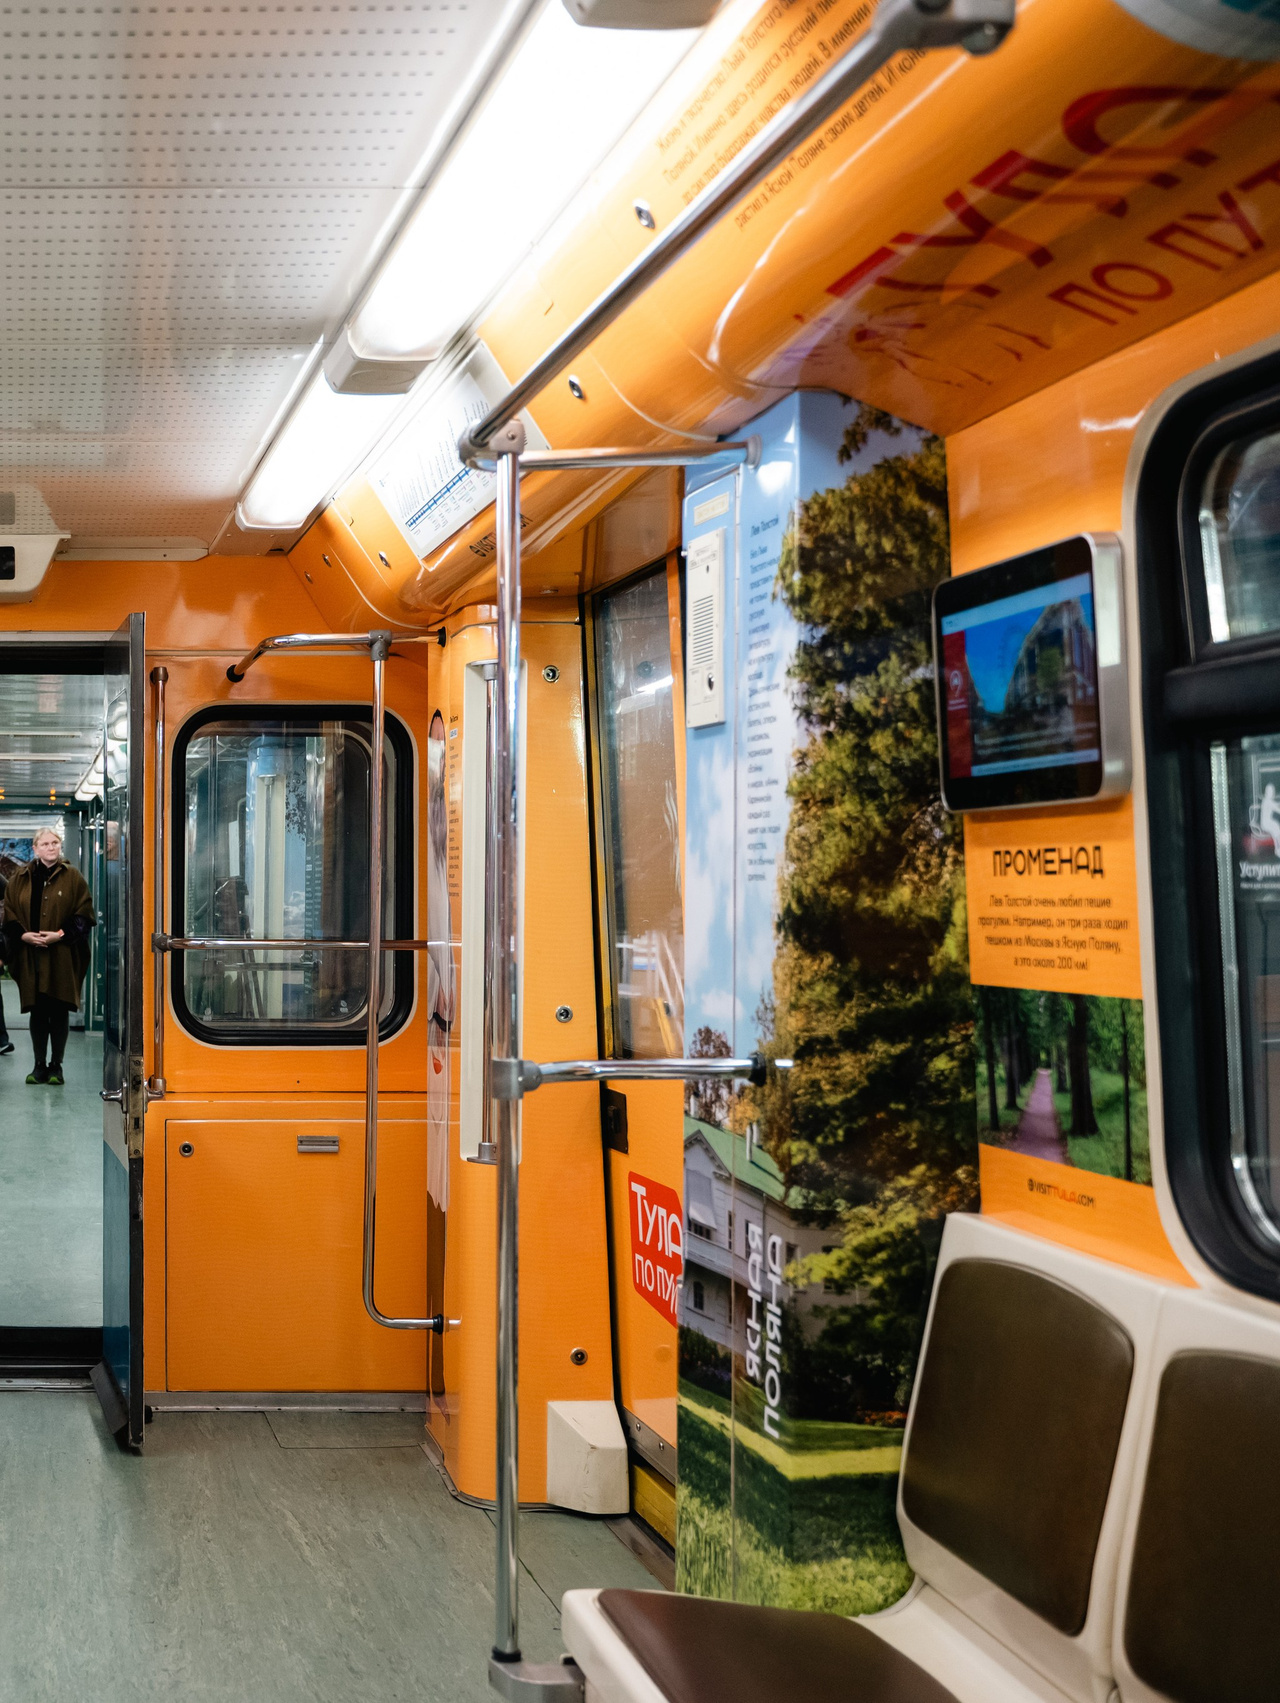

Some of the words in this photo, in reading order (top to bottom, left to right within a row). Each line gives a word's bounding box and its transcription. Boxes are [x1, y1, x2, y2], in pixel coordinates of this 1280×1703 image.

[780, 11, 819, 59] русский
[824, 111, 856, 144] своих
[1048, 262, 1174, 327] ПО
[993, 845, 1105, 879] ПРОМЕНАД
[989, 894, 1003, 908] Лев
[1003, 894, 1032, 908] Толстой
[1033, 896, 1057, 908] очень
[1056, 894, 1083, 908] любил
[1084, 896, 1111, 909] пешие
[1012, 915, 1054, 930] Например,
[1056, 918, 1066, 928] он
[1066, 918, 1081, 930] три
[1082, 918, 1102, 931] раза
[1103, 918, 1128, 931] ходил
[1024, 934, 1054, 949] Москвы
[1061, 934, 1087, 951] Ясную
[1033, 957, 1055, 968] около
[1056, 956, 1073, 970] 200
[1034, 1180, 1096, 1209] VISITTULA.COM
[631, 1181, 683, 1264] ТУЛА
[635, 1252, 655, 1292] ПО
[745, 1222, 763, 1381] ЯСНАЯ
[763, 1233, 783, 1440] ПОЛЯНА
